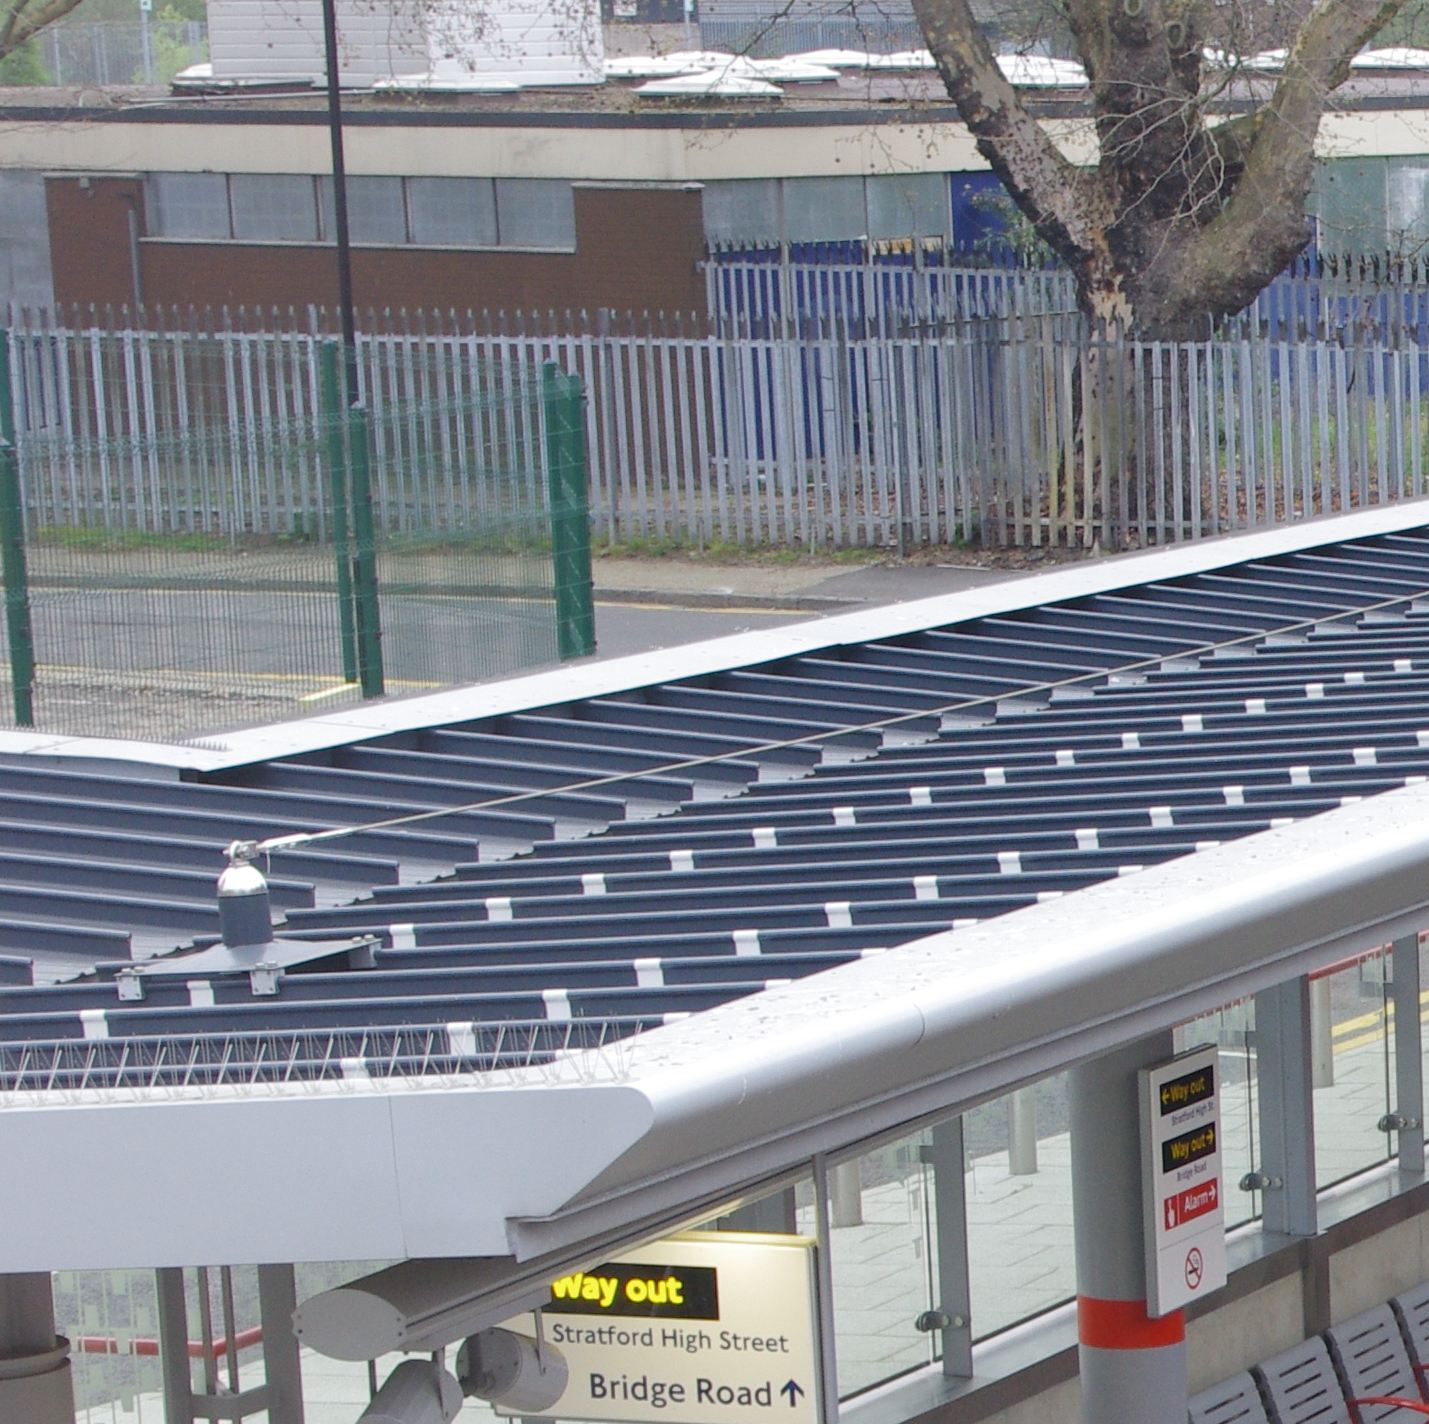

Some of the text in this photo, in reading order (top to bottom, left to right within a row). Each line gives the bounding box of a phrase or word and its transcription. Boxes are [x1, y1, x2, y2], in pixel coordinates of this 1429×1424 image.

[1170, 1076, 1205, 1102] Way out
[1171, 1108, 1195, 1126] Stratford
[1171, 1133, 1206, 1160] Way out
[1177, 1161, 1207, 1182] Bridge Road
[1184, 1190, 1209, 1213] Alarm
[552, 1272, 684, 1307] Way out
[552, 1323, 790, 1353] Stratford High Street
[589, 1372, 772, 1408] Bridge Road
